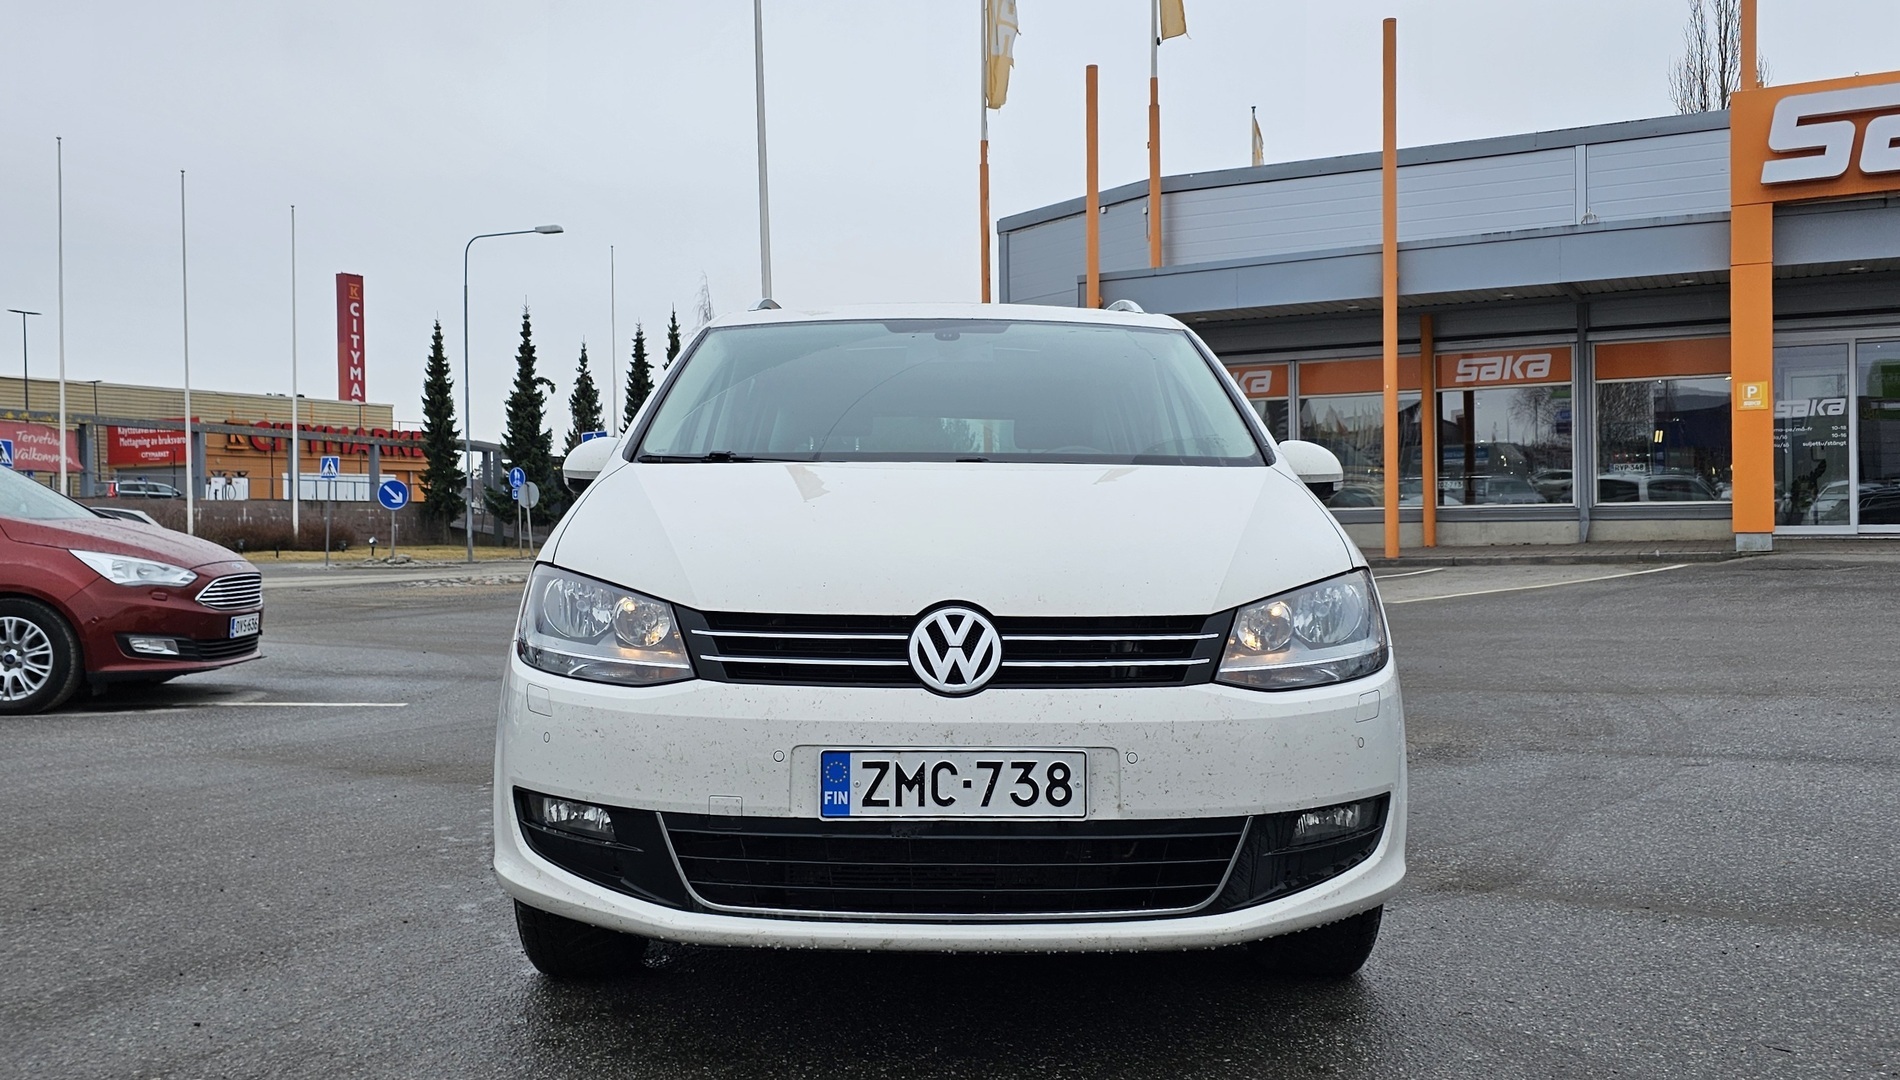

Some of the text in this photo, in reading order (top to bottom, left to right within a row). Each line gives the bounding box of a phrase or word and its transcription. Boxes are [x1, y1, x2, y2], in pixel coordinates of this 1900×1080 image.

[349, 302, 362, 402] CITYMA
[1747, 386, 1758, 398] P
[141, 450, 170, 459] CITYMARKET
[824, 791, 849, 805] FIN
